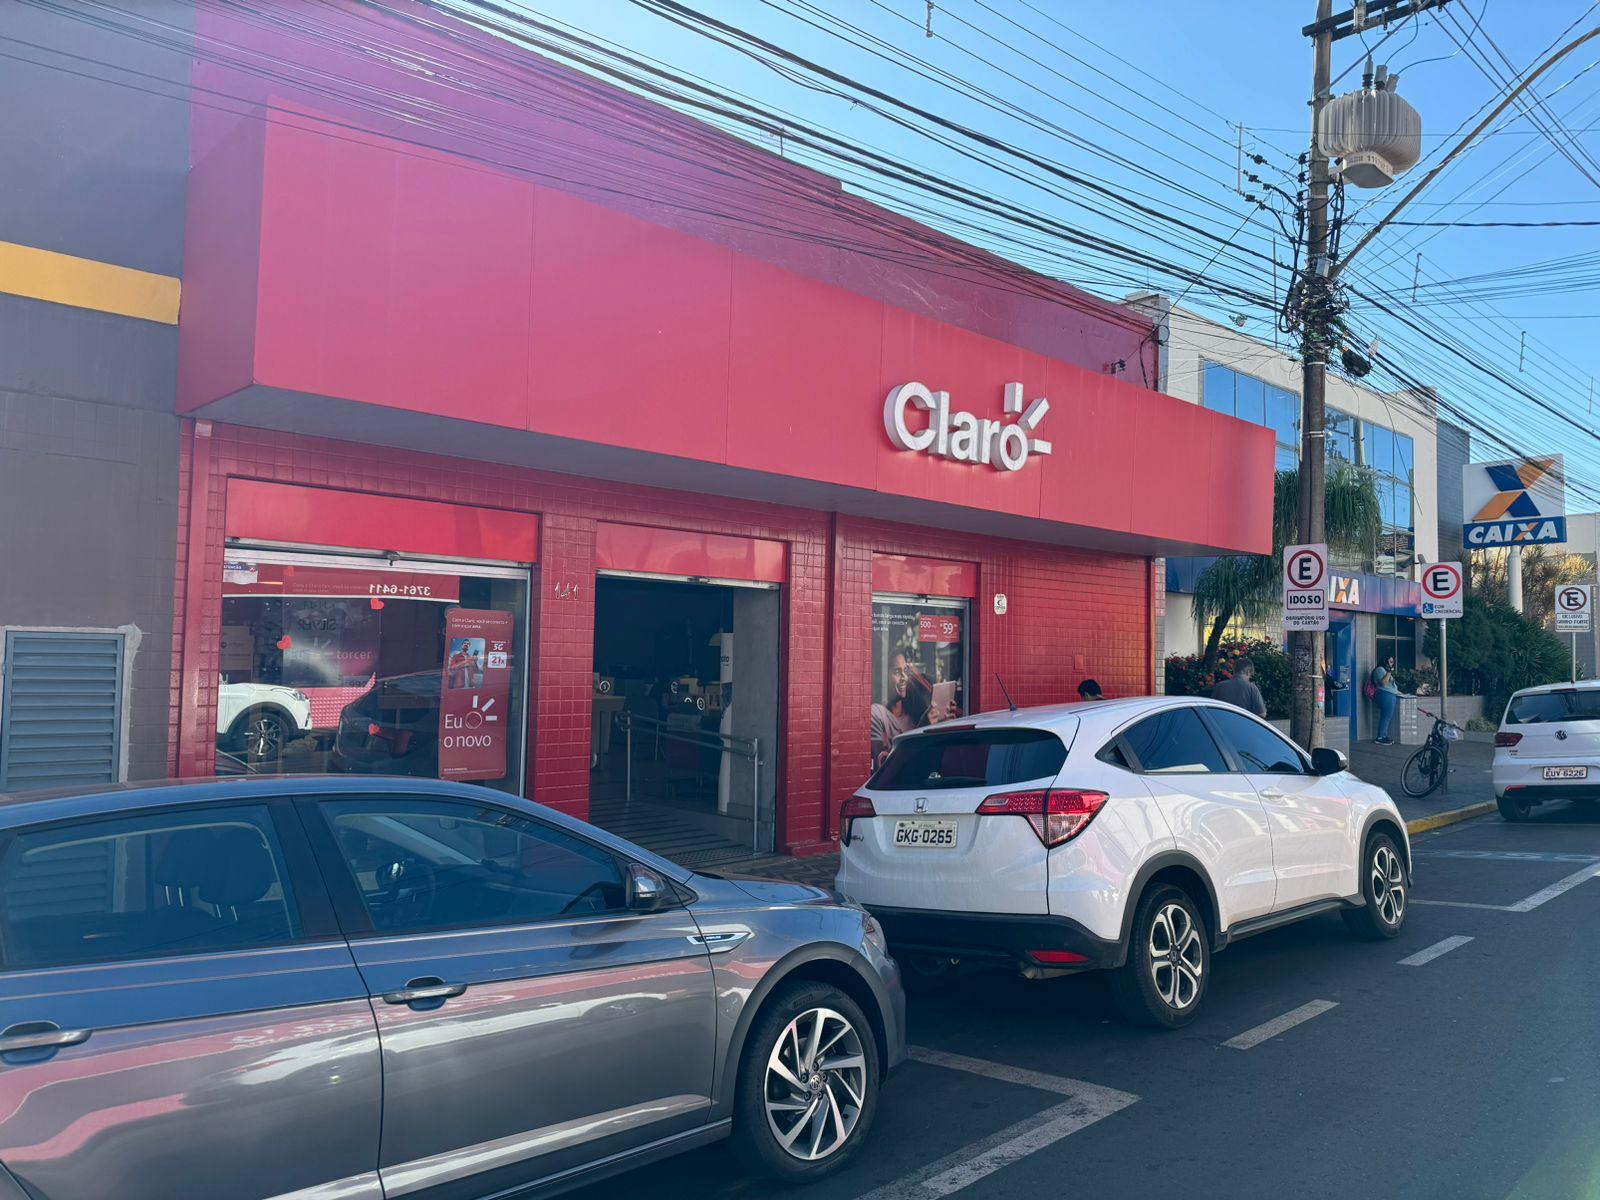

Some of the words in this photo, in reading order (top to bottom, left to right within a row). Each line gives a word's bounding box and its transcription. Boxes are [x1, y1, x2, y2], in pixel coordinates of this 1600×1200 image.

[884, 382, 1028, 471] Claro
[1468, 521, 1558, 543] CAIXA
[1299, 557, 1312, 580] E
[1432, 571, 1450, 591] E
[1328, 575, 1360, 605] IXA
[1289, 595, 1321, 605] IDOSO
[1566, 592, 1579, 607] E
[943, 622, 954, 635] 59
[336, 649, 373, 660] torcer
[493, 643, 504, 651] 5G
[445, 713, 463, 729] Eu
[443, 735, 453, 748] o
[456, 734, 492, 748] novo
